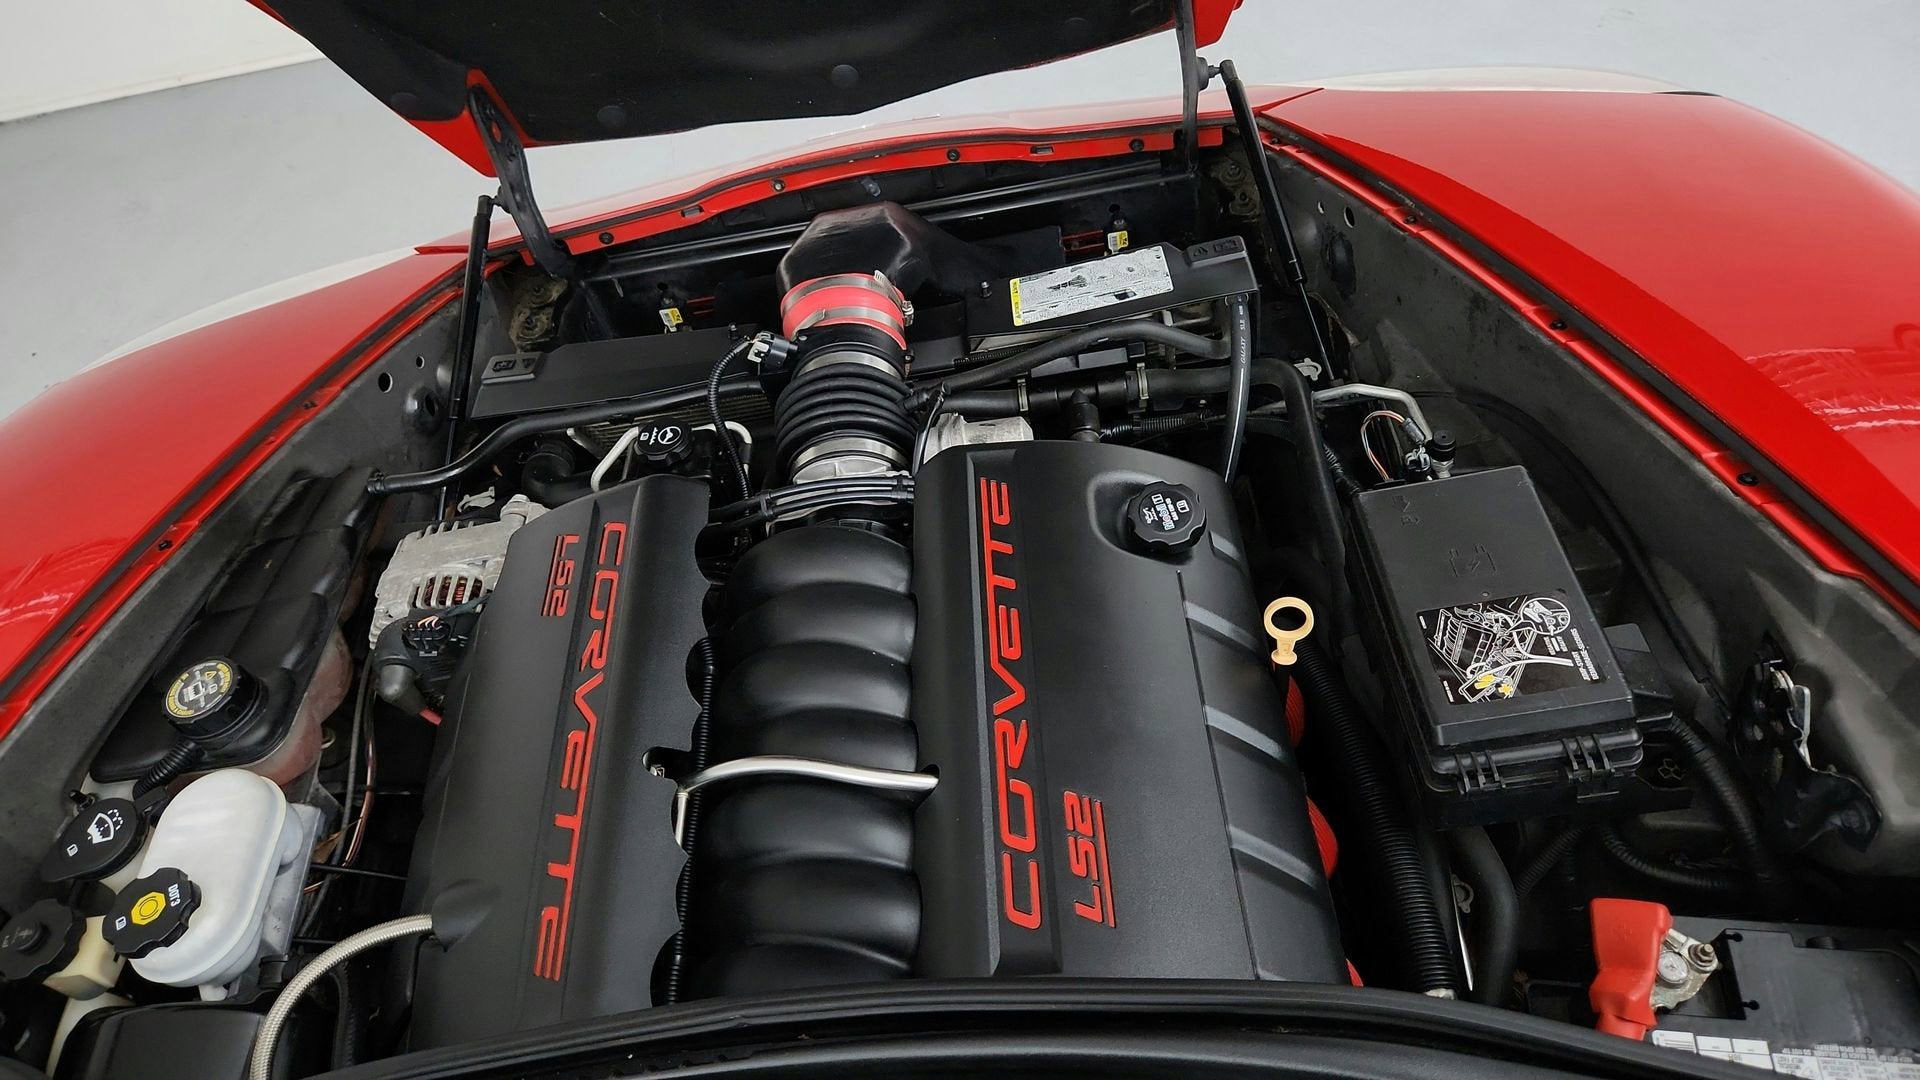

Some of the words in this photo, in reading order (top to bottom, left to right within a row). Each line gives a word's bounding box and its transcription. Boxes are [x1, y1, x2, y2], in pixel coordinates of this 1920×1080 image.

[543, 534, 580, 617] LS2
[981, 477, 1043, 931] CORVETTE
[534, 522, 627, 979] CORVETTE
[1064, 791, 1117, 928] LS2
